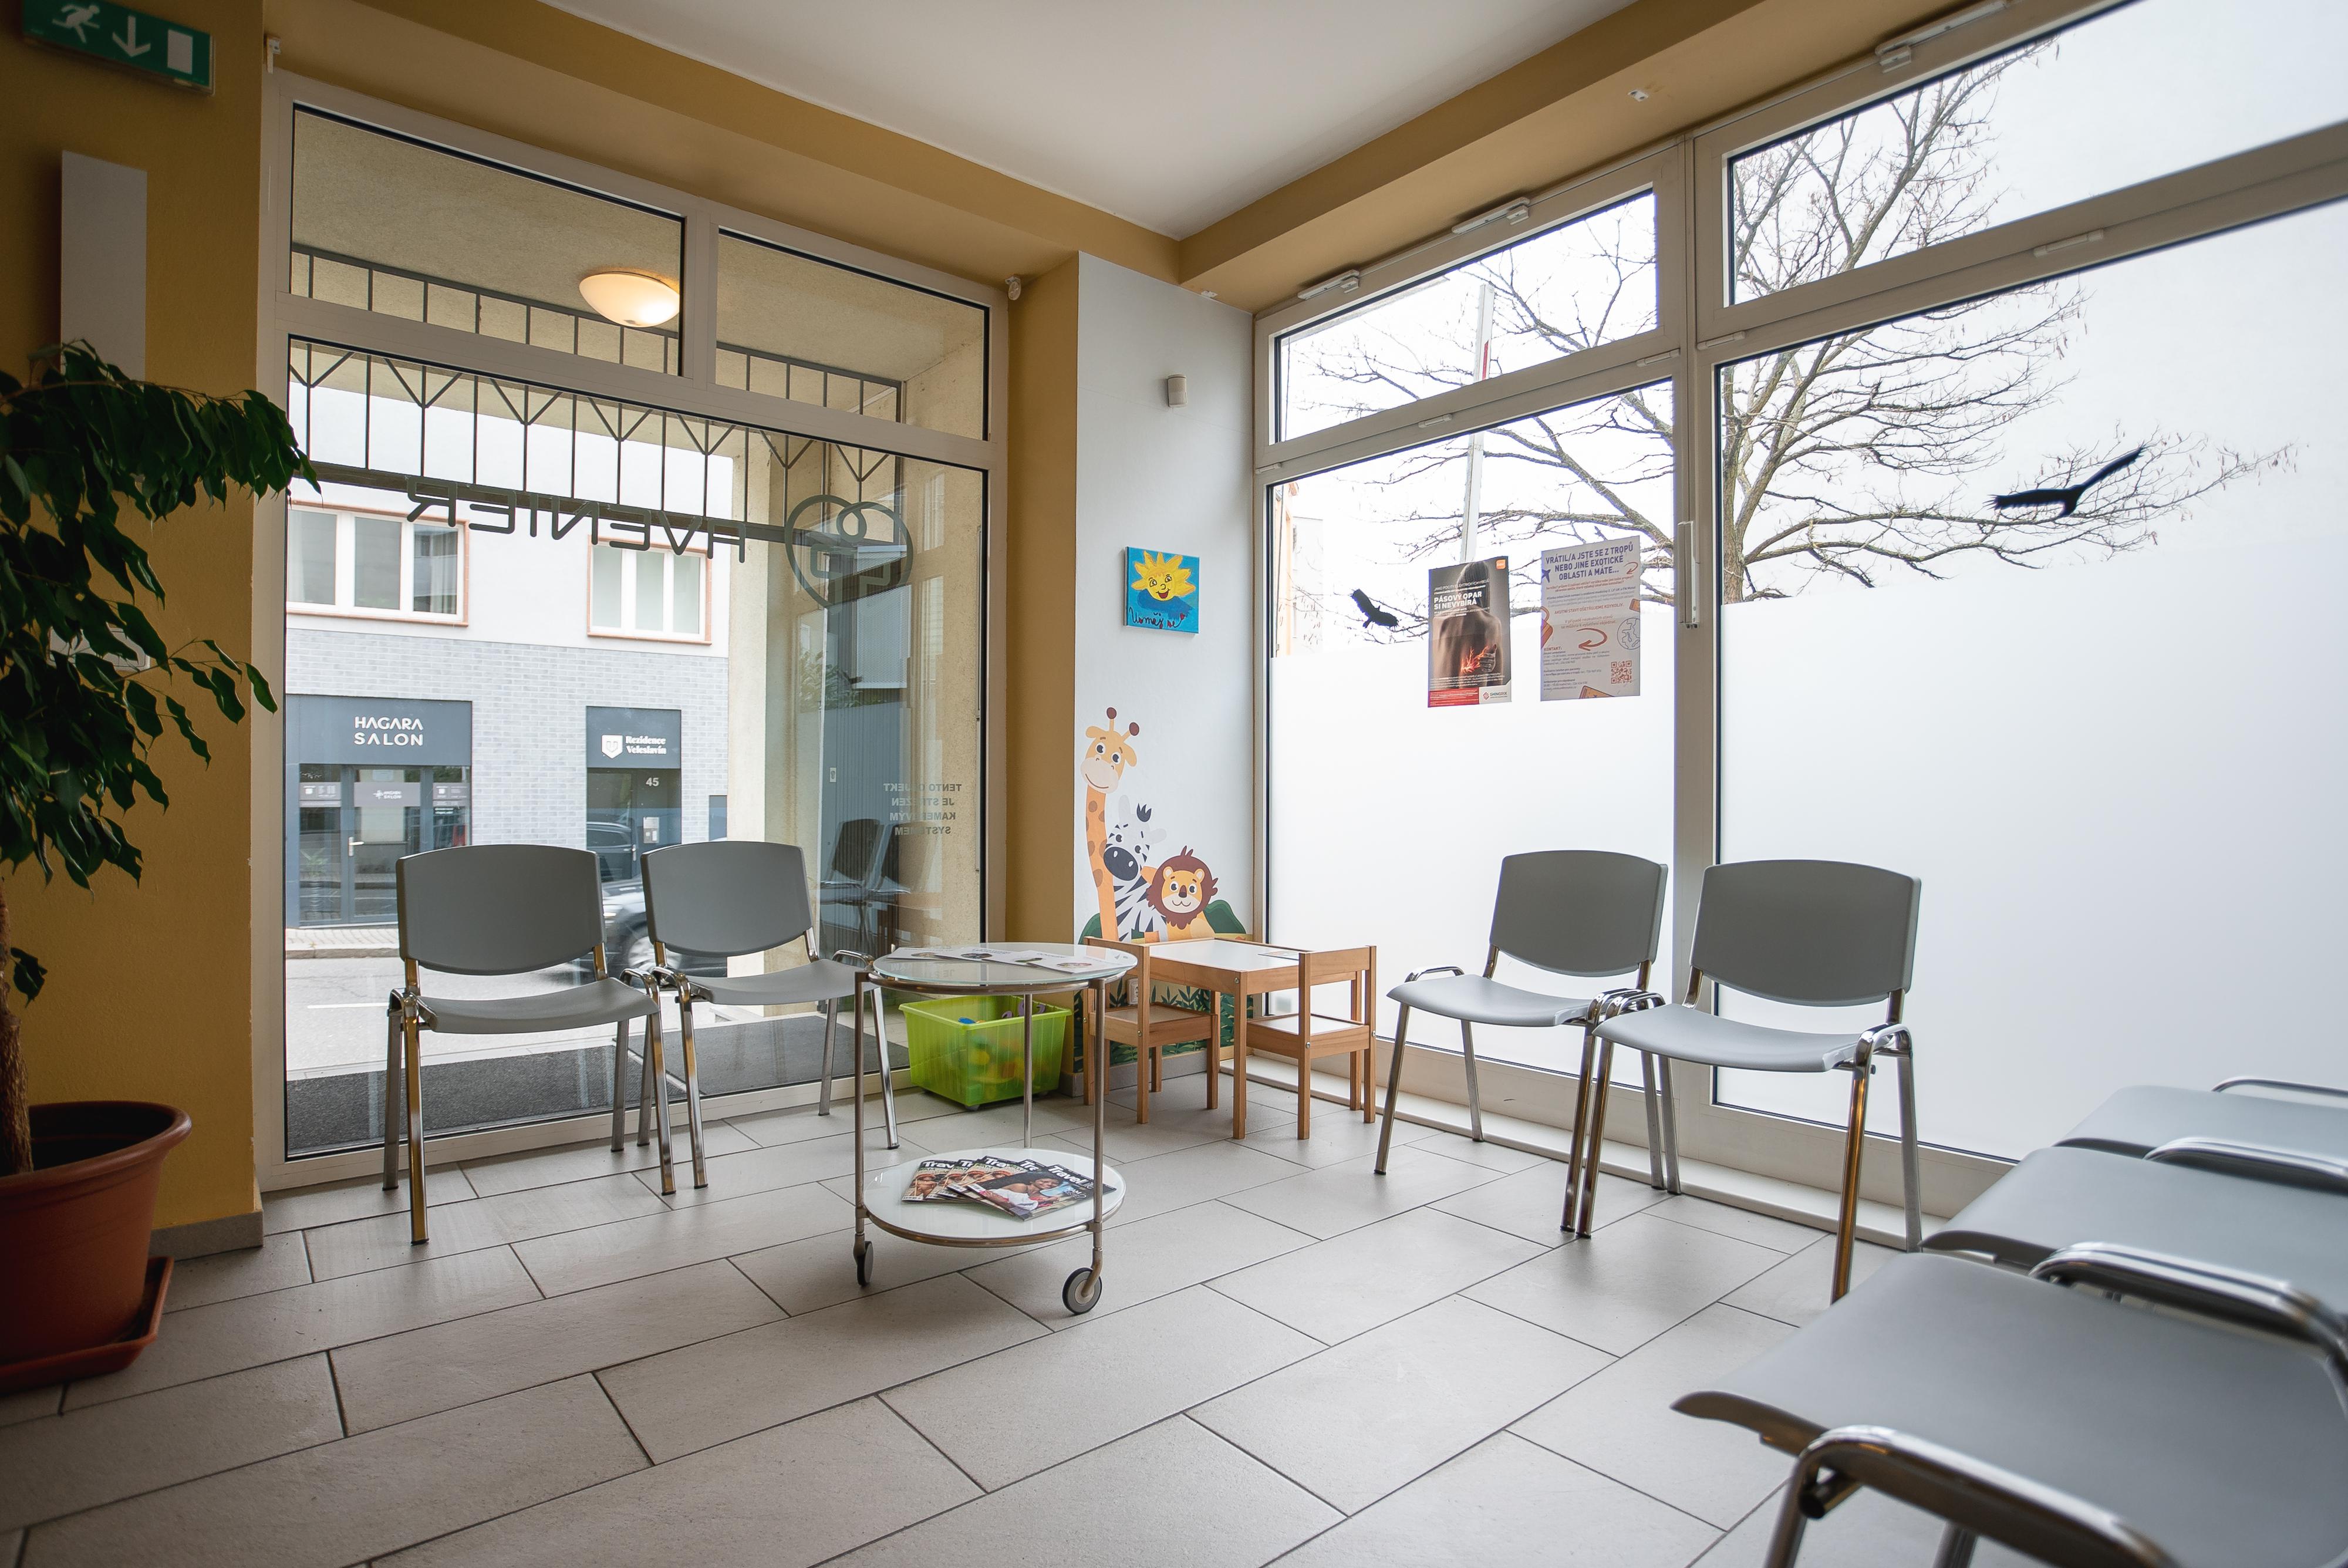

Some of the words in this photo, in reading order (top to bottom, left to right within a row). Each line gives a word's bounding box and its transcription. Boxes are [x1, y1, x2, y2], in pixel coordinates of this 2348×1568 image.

[1546, 552, 1576, 564] VRÁTIL/A
[1578, 551, 1593, 559] JSTE
[1595, 549, 1603, 557] SE
[1610, 541, 1633, 554] TROPŮ
[1555, 563, 1573, 572] NEBO
[1591, 554, 1624, 567] EXOTICKÉ
[1559, 570, 1587, 581] OBLASTI
[1434, 592, 1461, 603] PÁSOVÝ
[1442, 598, 1477, 609] NEVYBÍRÁ
[355, 716, 424, 731] HAGARA
[354, 732, 423, 746] SALON
[625, 736, 666, 745] Rezidence
[626, 745, 667, 754] Veleslavín
[646, 777, 659, 787] 45
